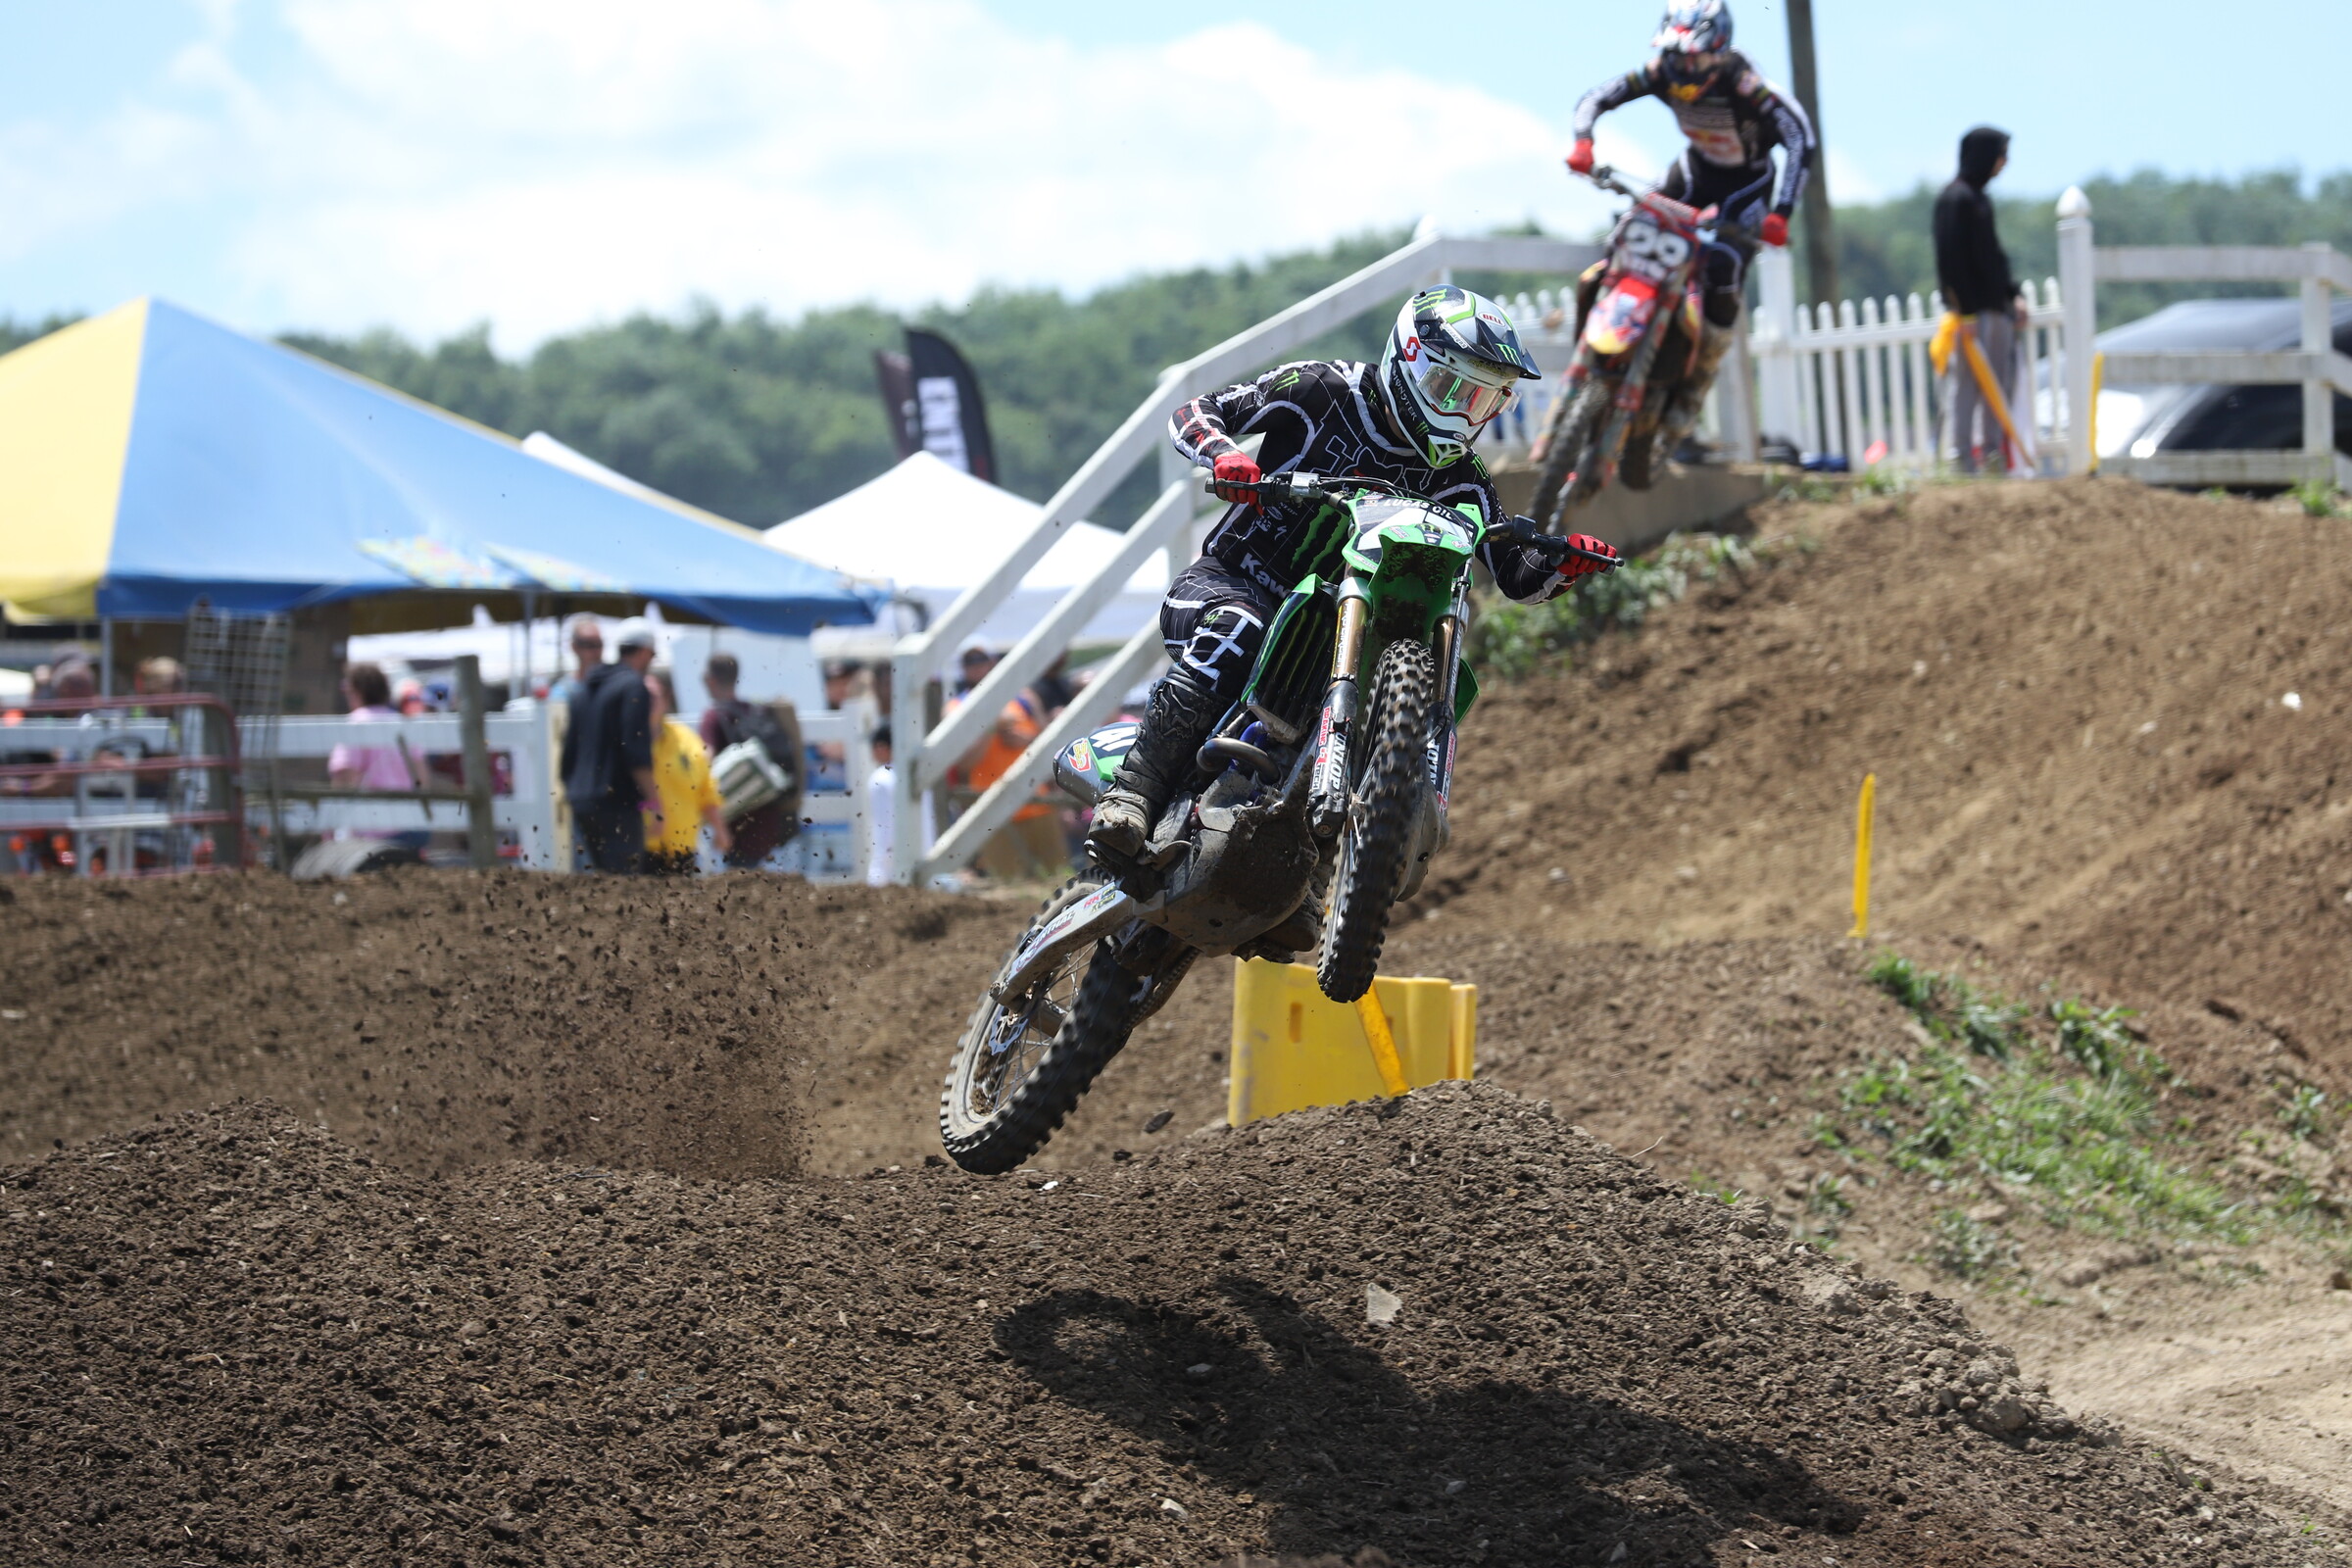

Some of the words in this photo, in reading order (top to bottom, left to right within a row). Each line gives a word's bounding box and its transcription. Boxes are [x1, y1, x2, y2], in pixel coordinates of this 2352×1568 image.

[1482, 313, 1502, 325] BELL
[1392, 369, 1418, 421] MONSTER
[1383, 498, 1431, 510] LUCAS
[1432, 506, 1452, 520] OIL
[1330, 731, 1348, 790] UNLOP
